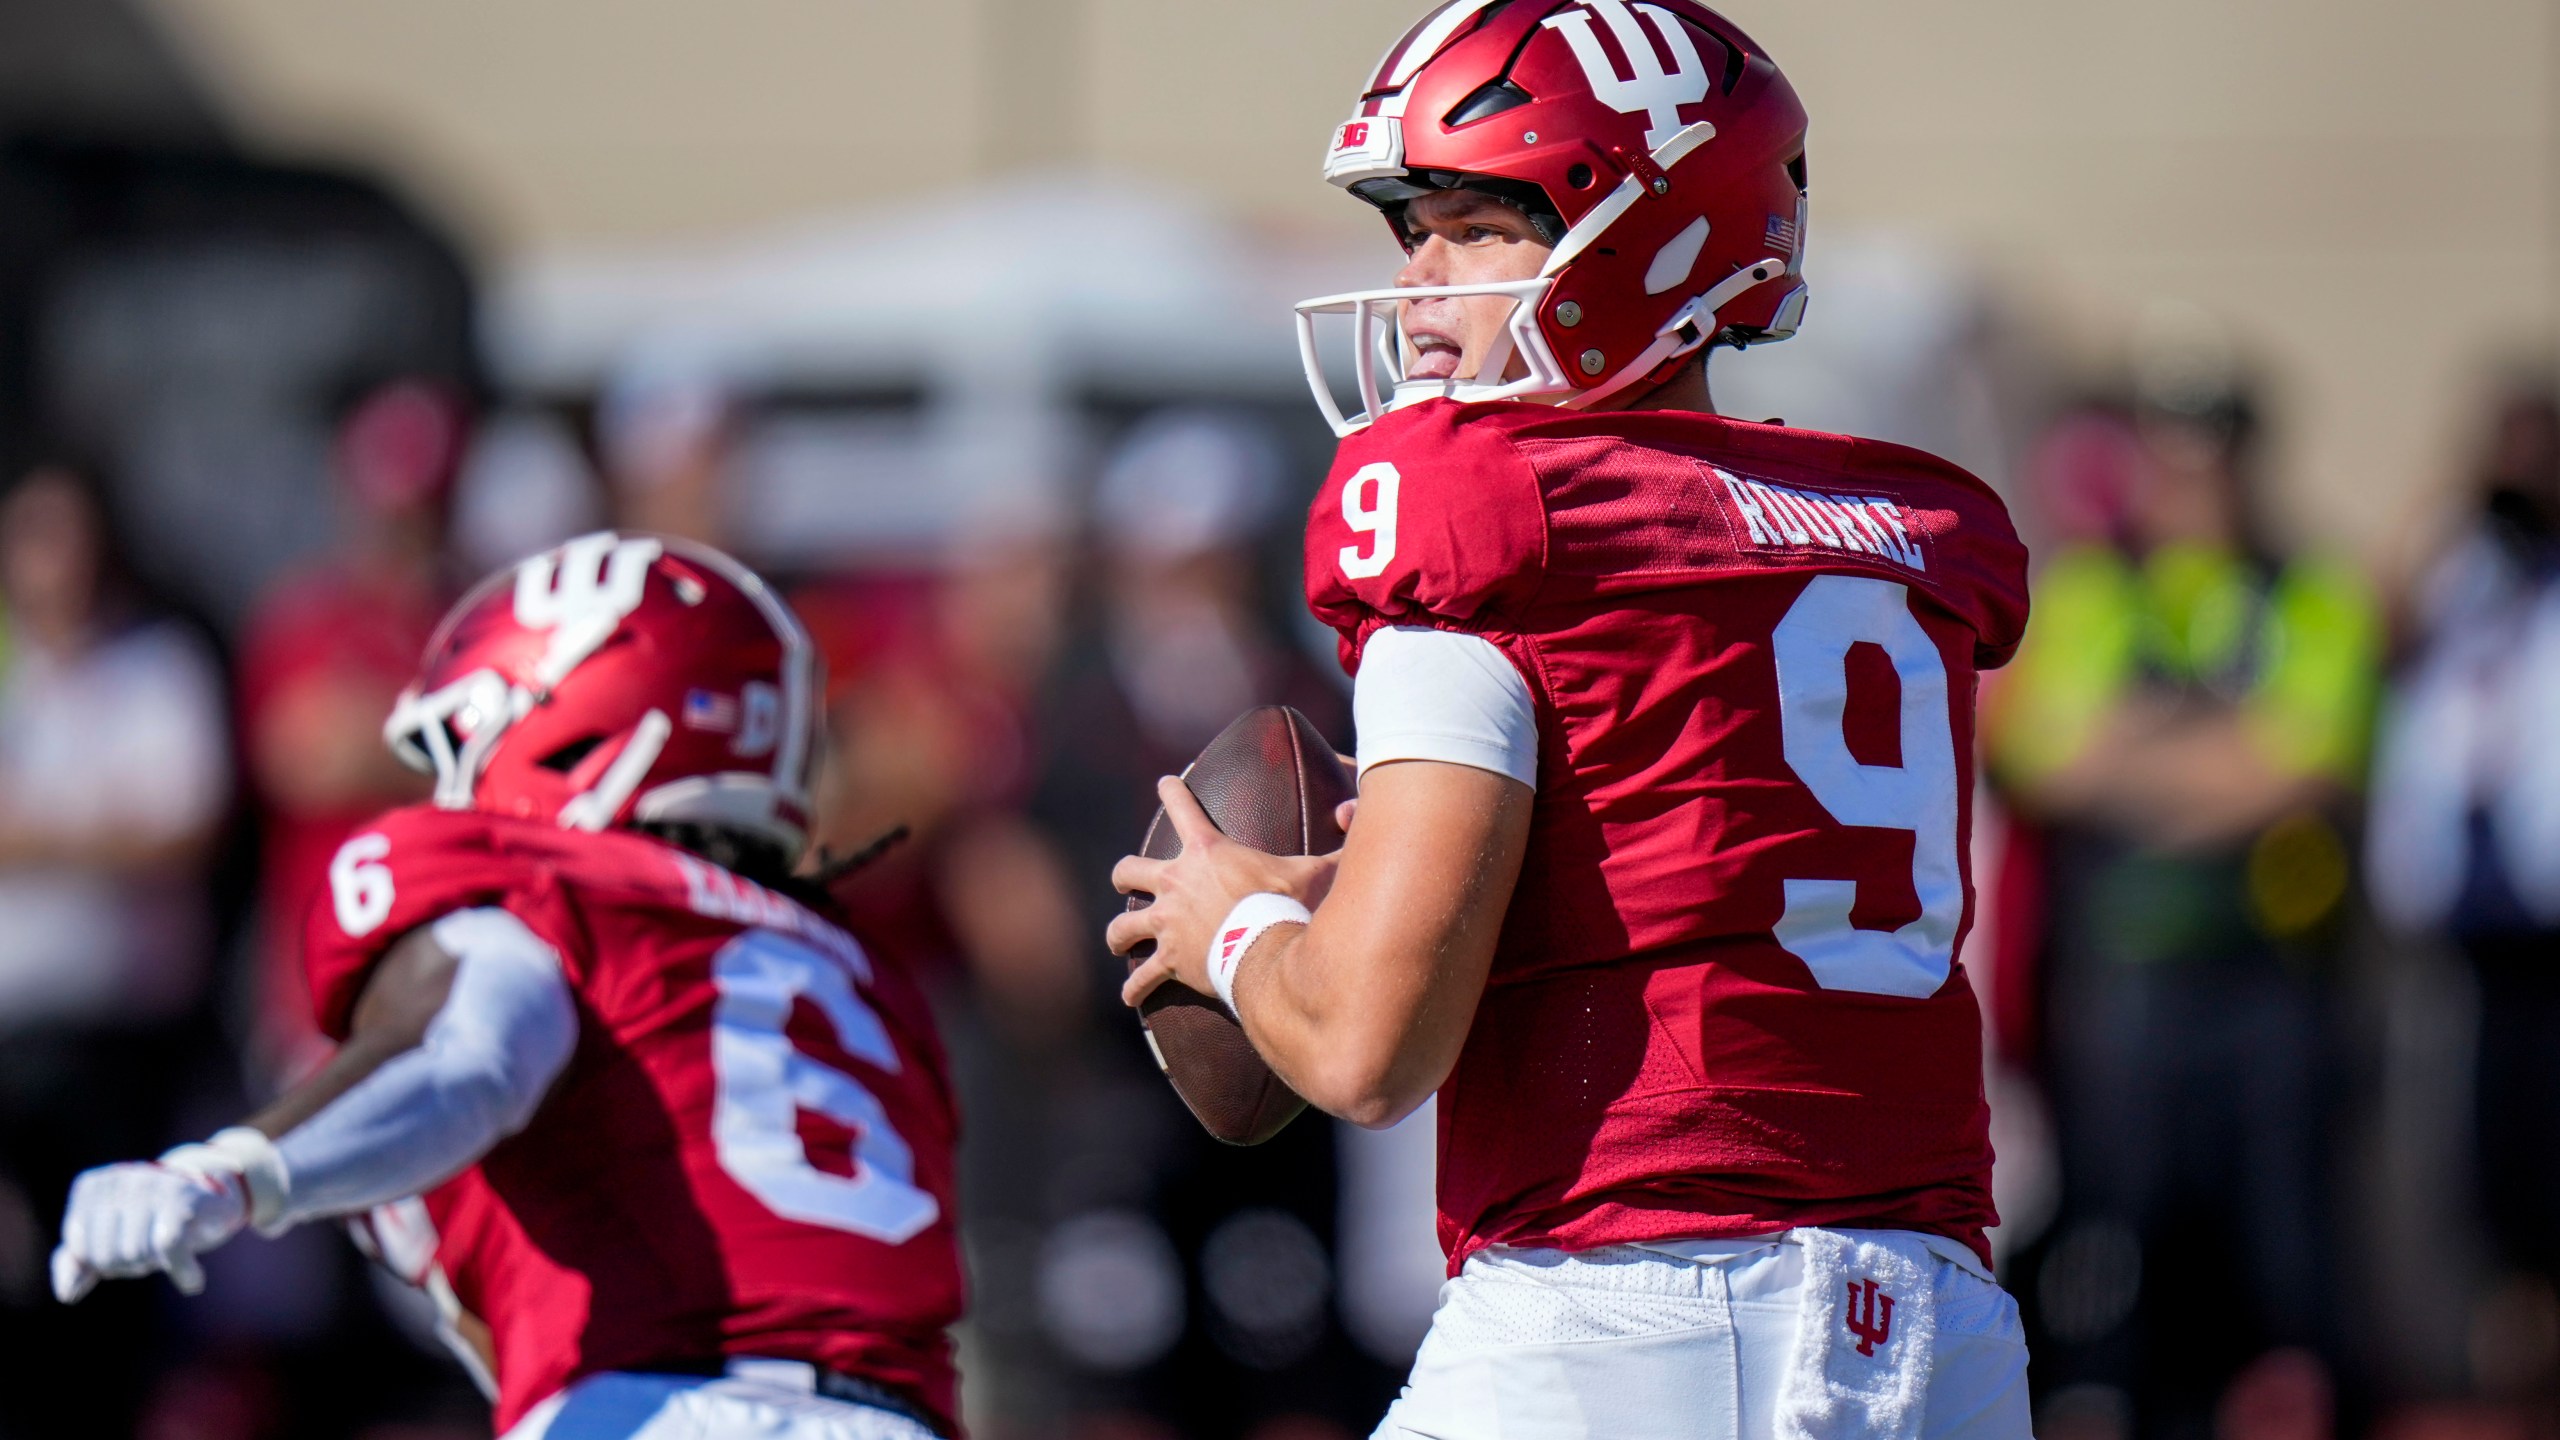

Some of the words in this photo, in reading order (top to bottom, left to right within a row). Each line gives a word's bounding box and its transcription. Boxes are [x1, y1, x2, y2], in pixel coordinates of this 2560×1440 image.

[1339, 461, 1401, 580] 9
[1713, 469, 1926, 573] ROURKE
[1771, 574, 1964, 1000] 9
[328, 831, 397, 939] 6
[710, 928, 941, 1246] 6
